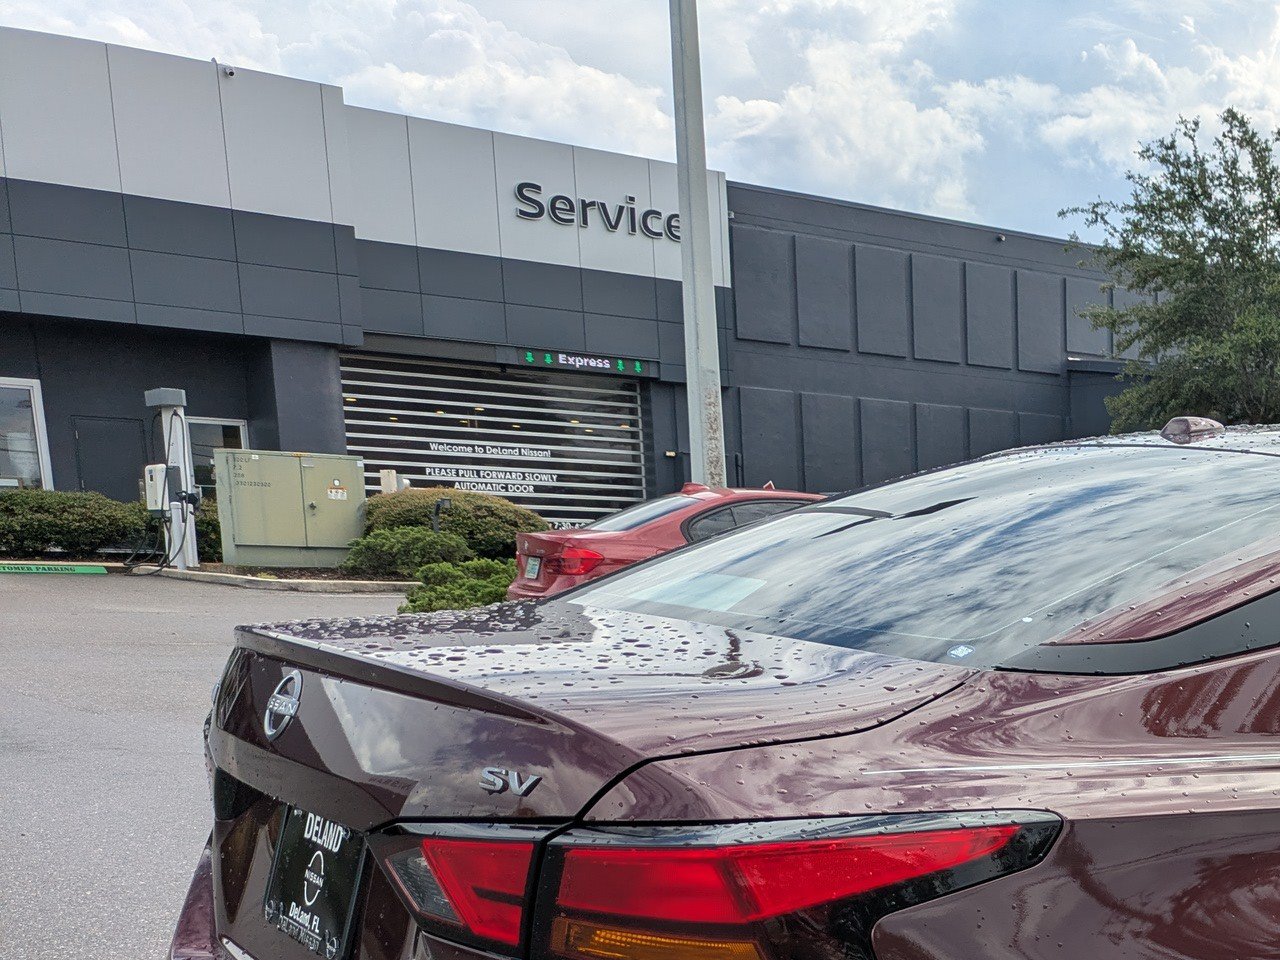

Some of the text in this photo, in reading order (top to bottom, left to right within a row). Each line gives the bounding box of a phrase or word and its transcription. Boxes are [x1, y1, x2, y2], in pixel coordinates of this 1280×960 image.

[514, 181, 681, 243] Service
[558, 353, 610, 368] Express
[429, 442, 551, 458] Welcome to DeLand Nissan!
[425, 467, 557, 482] PLEASE PULL FORWARD SLOWLY
[454, 482, 534, 493] AUTOMATIC DOOR
[479, 766, 540, 796] SV
[304, 812, 343, 853] DELAND
[304, 868, 324, 888] NISSAN
[311, 914, 320, 934] FL
